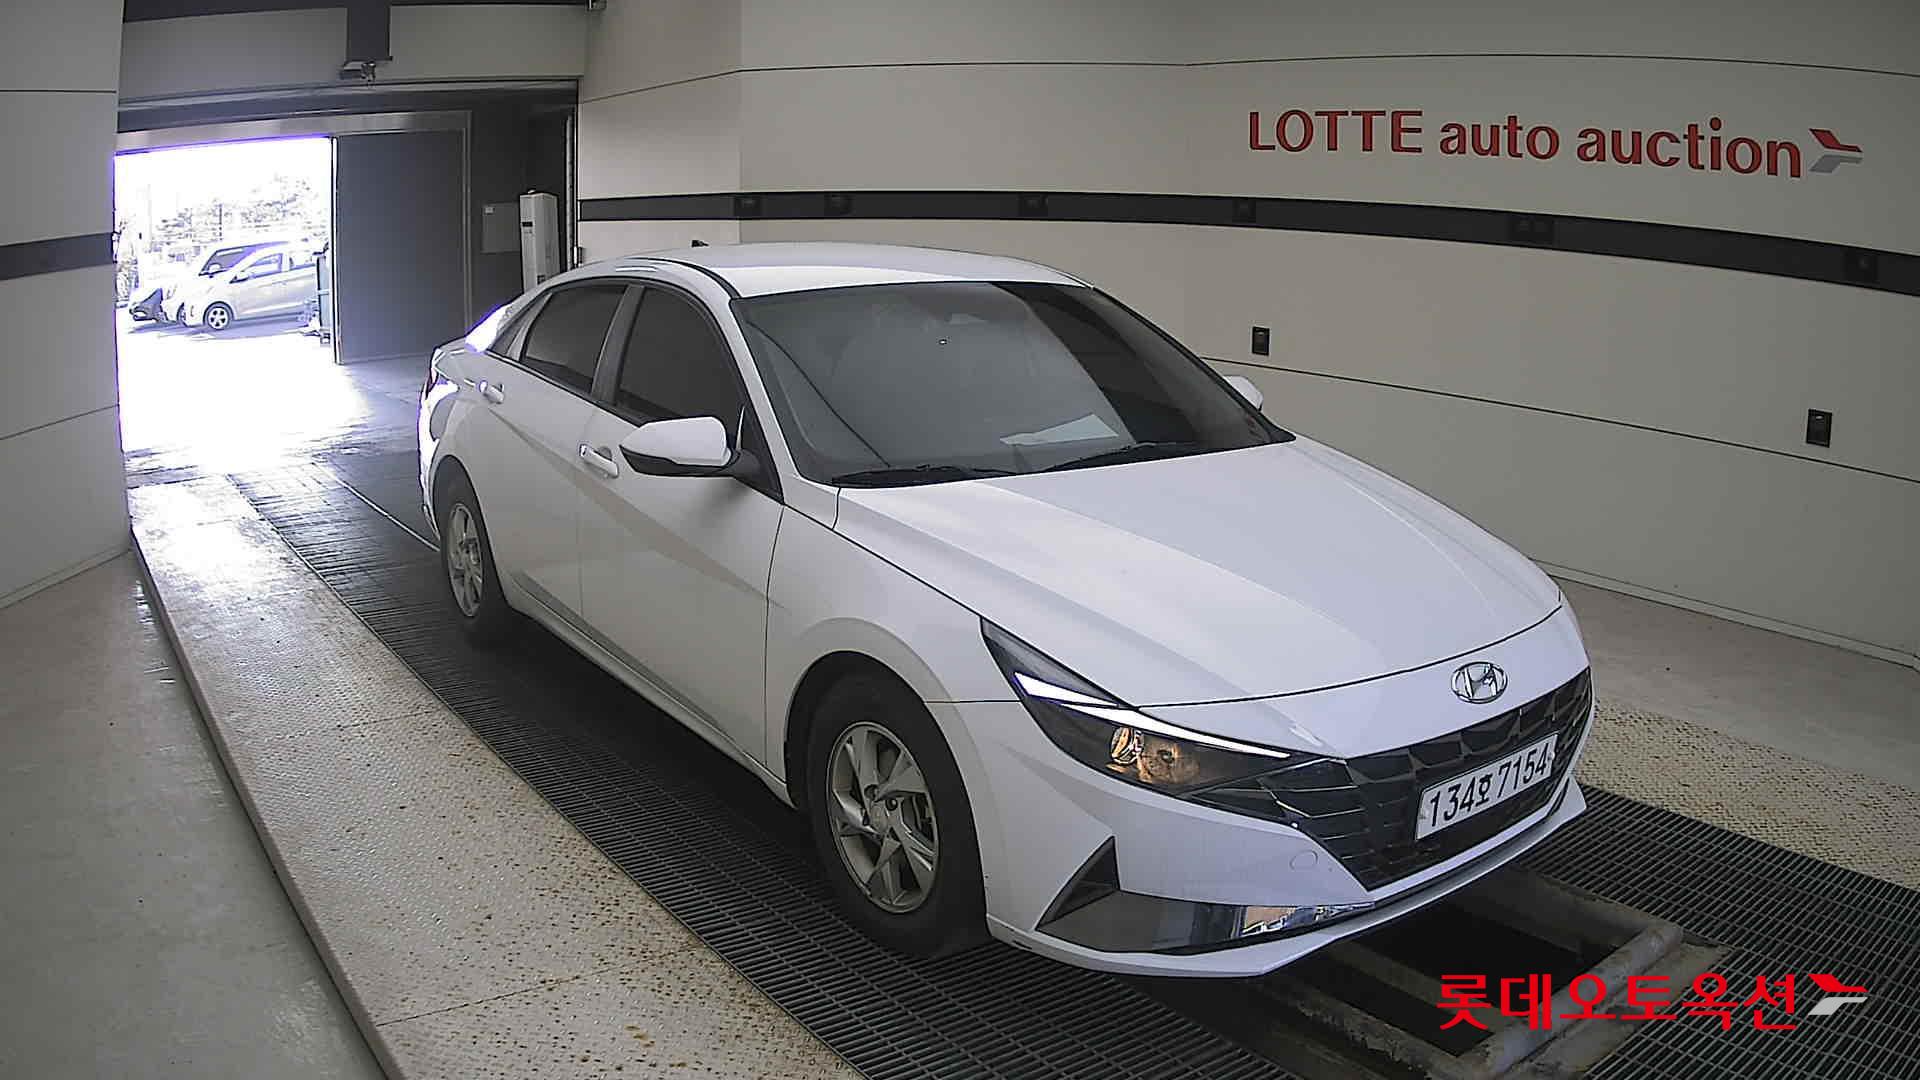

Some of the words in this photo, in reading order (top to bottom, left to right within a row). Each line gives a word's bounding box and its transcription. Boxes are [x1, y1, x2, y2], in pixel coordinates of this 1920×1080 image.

[1248, 109, 1424, 154] LOTTE
[1438, 114, 1561, 160] auto
[1575, 116, 1802, 178] auction
[1497, 742, 1549, 798] 7154
